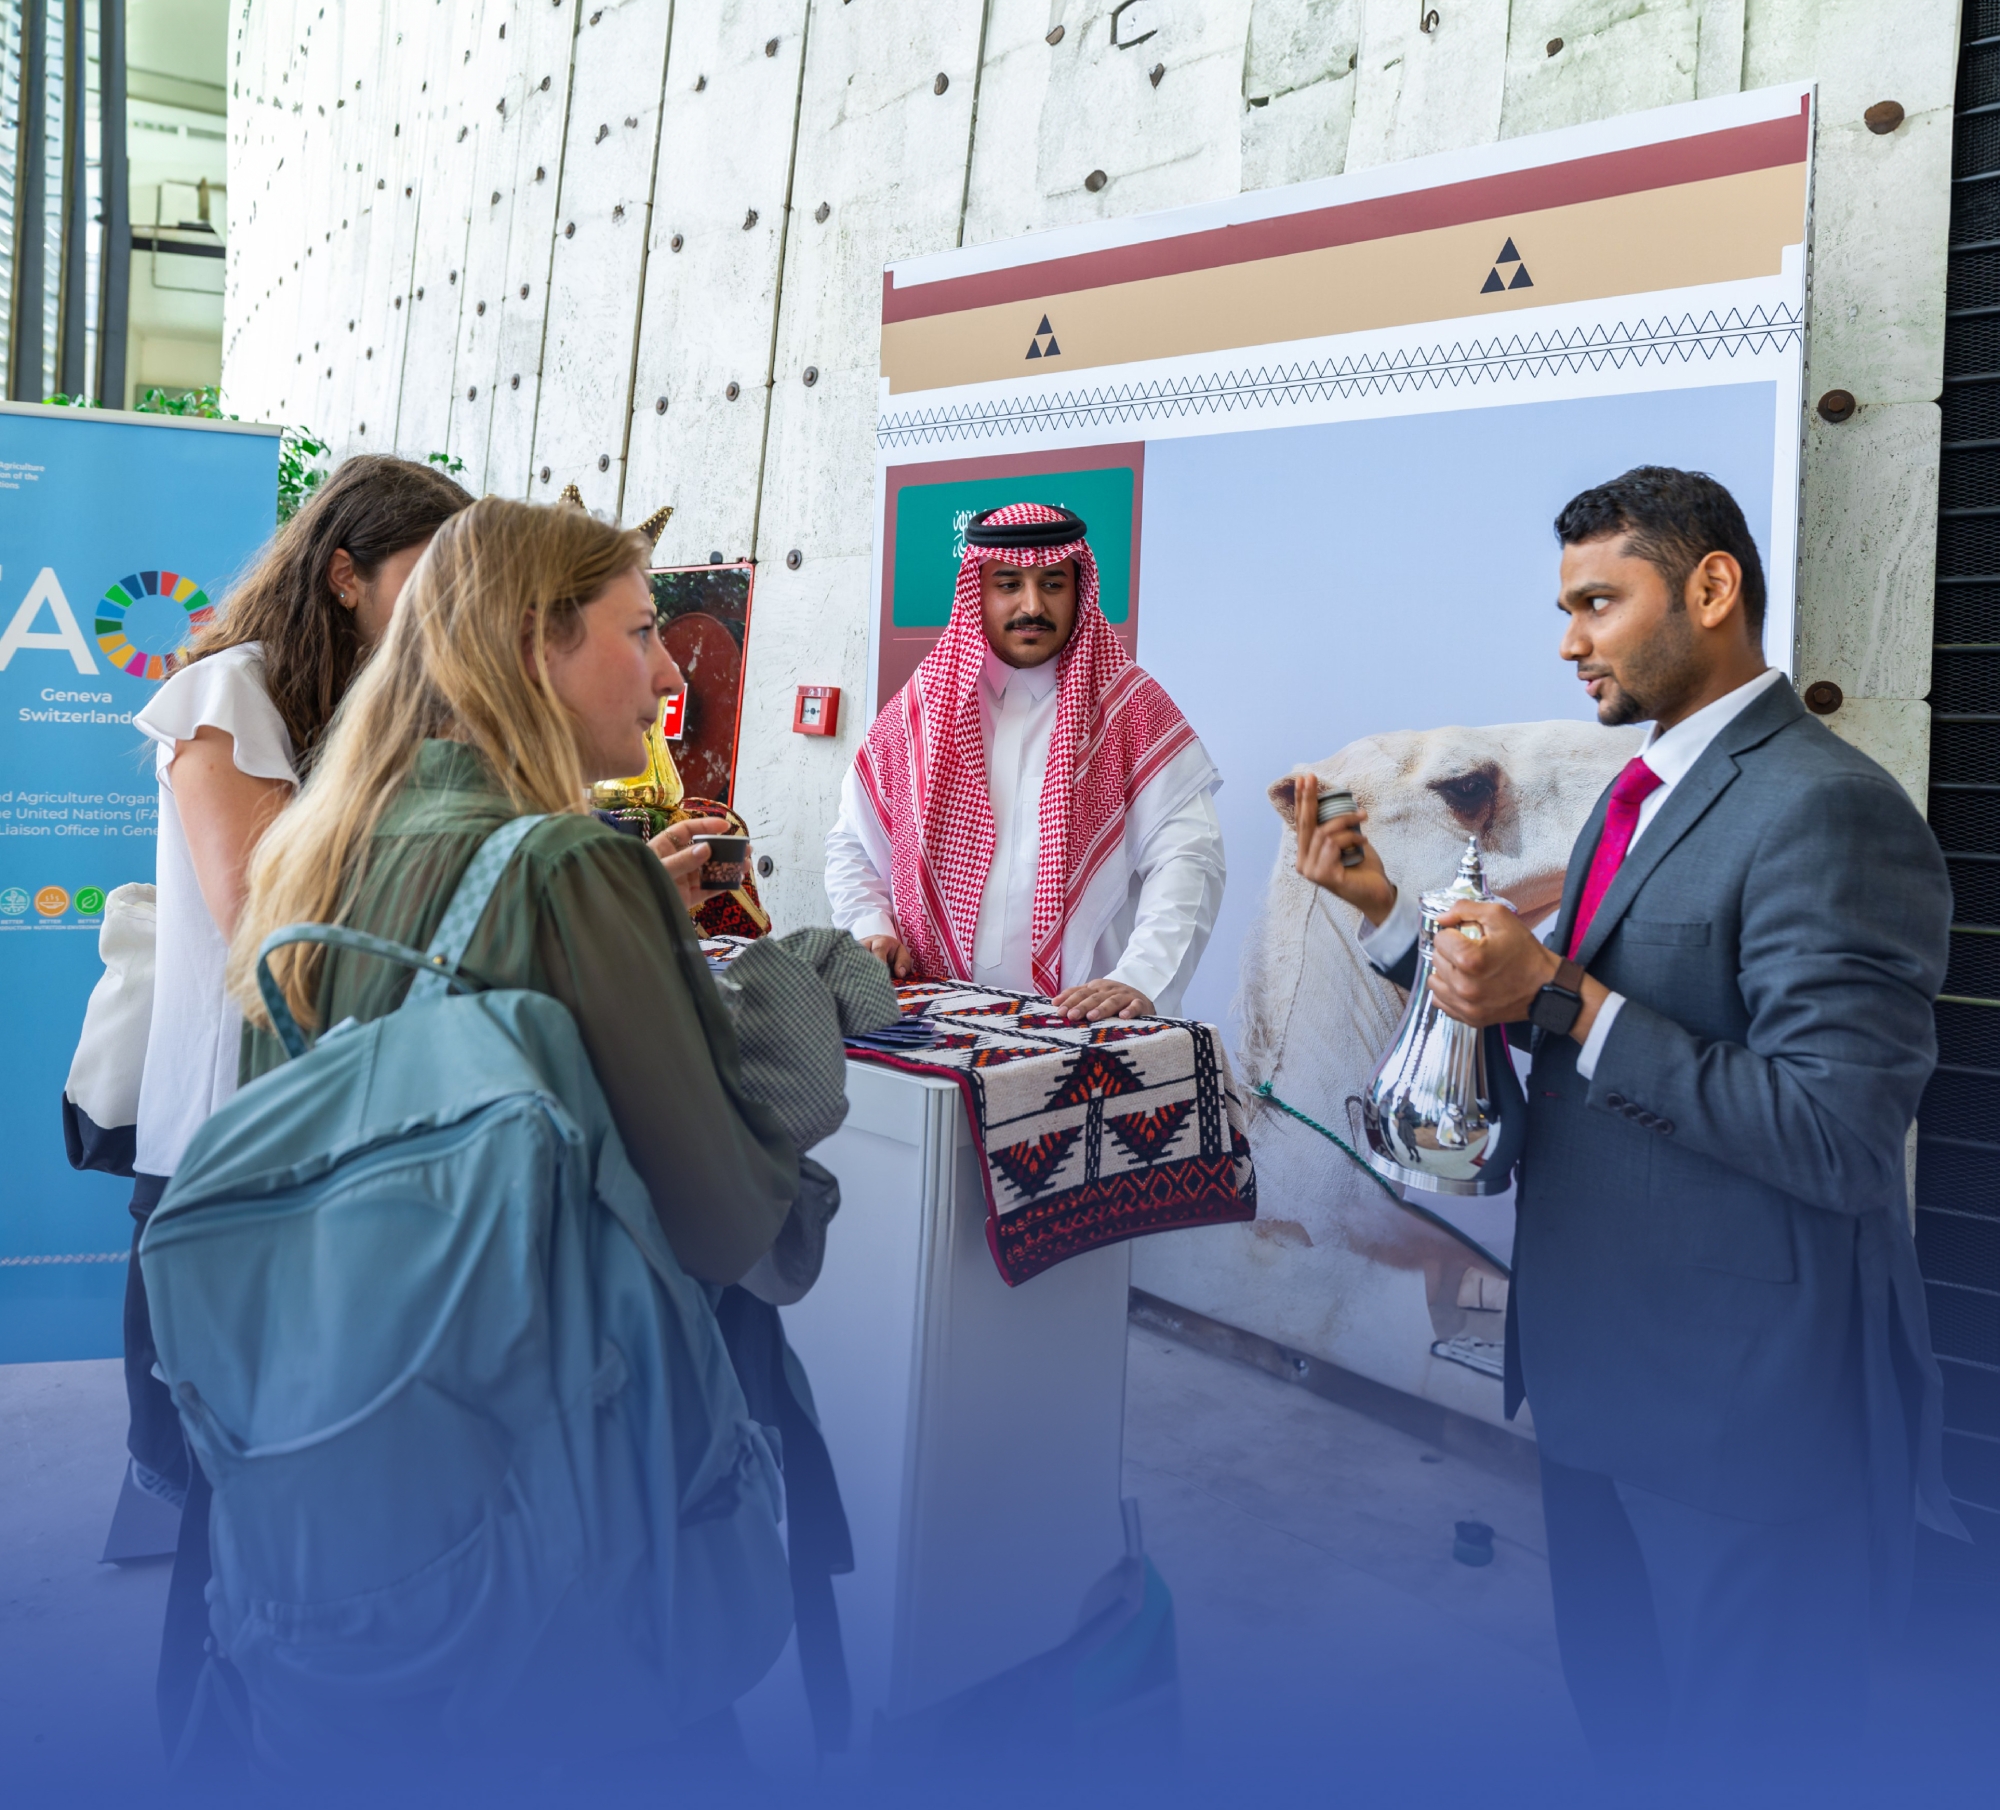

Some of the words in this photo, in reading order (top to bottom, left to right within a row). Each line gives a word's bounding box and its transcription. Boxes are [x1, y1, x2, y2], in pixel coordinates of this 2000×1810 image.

[41, 688, 113, 703] Geneva
[19, 708, 132, 724] Switzerland
[16, 791, 103, 806] Agriculture
[16, 808, 68, 819] United
[72, 808, 131, 820] Nations
[54, 824, 100, 836] Office
[104, 825, 118, 836] in
